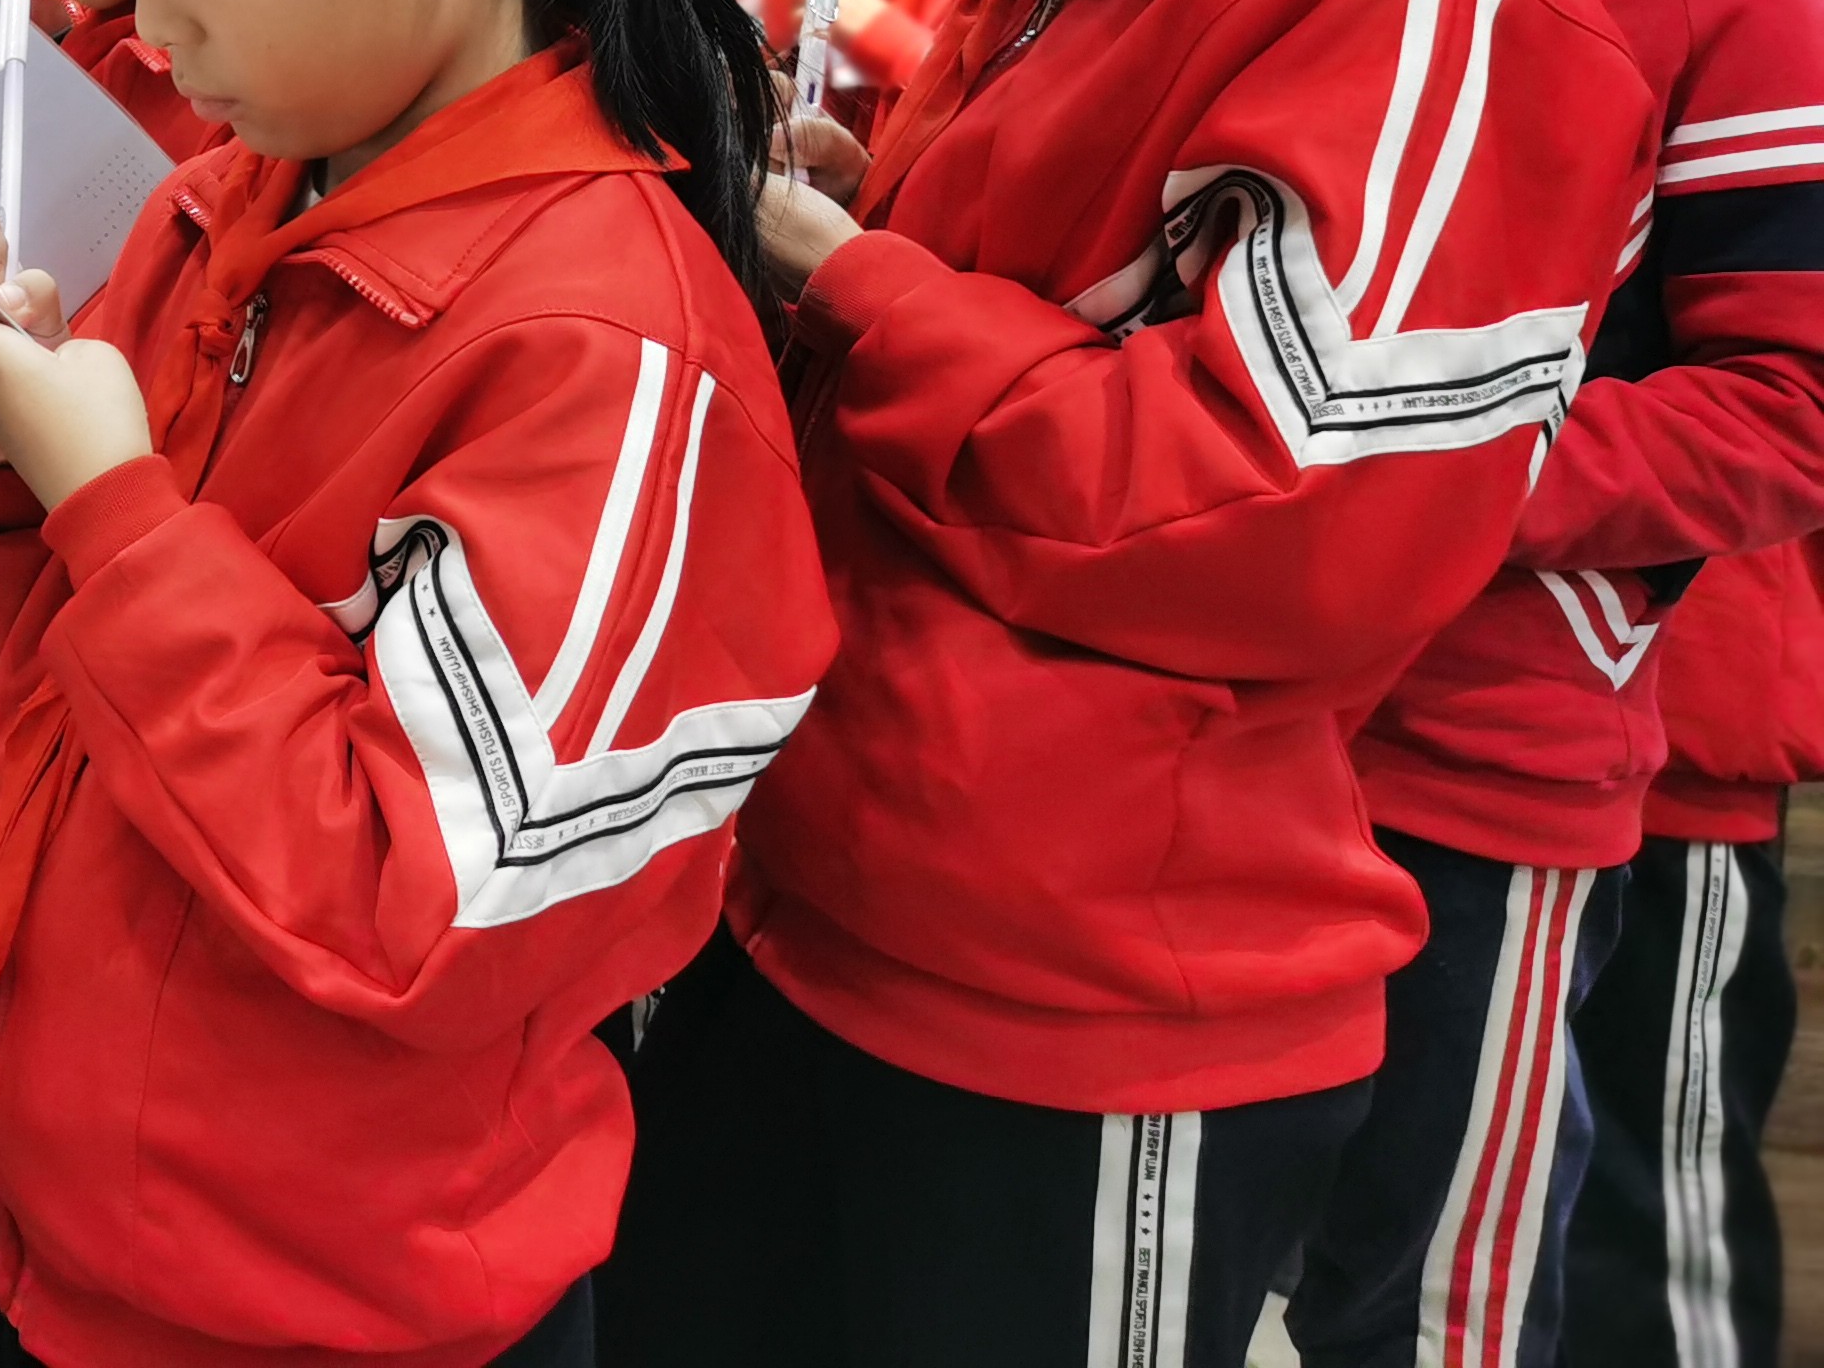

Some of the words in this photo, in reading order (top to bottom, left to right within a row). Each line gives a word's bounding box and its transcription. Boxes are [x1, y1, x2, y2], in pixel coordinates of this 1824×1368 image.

[473, 716, 499, 757] FUSHI
[488, 756, 516, 808] SPORTS
[1137, 1247, 1151, 1269] BEST
